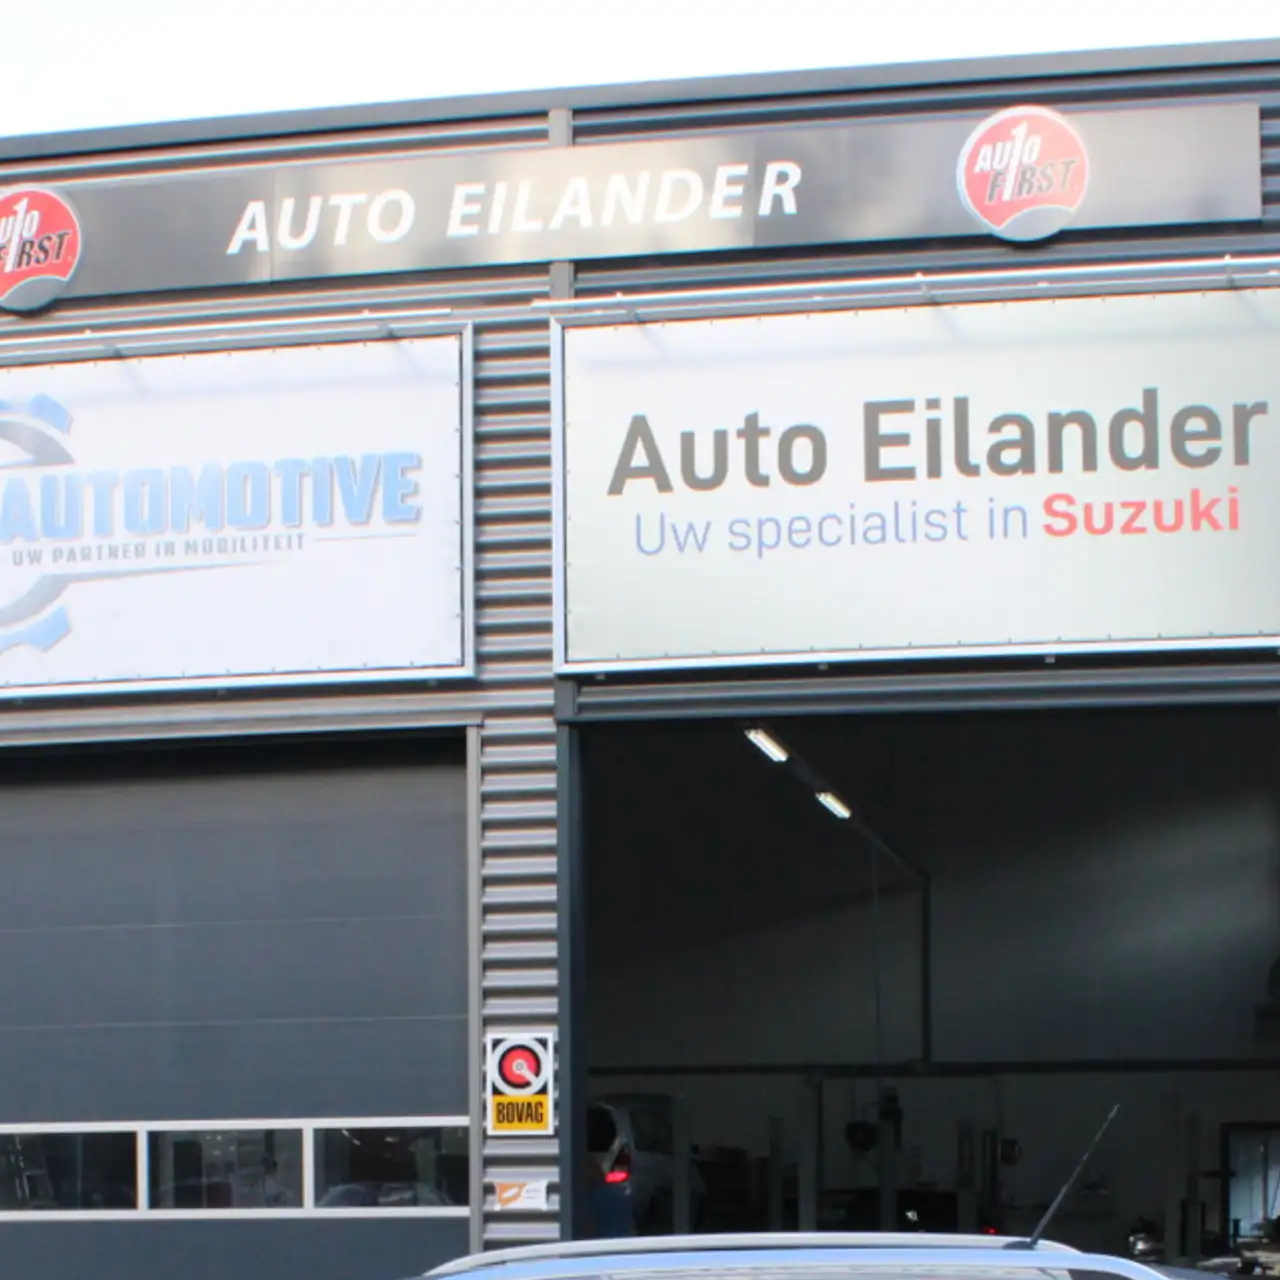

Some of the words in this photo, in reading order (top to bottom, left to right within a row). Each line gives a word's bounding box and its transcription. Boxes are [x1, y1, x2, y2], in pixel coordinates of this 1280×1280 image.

[226, 188, 417, 255] AUTO
[446, 161, 802, 239] EILANDER
[607, 409, 827, 497] Auto
[863, 386, 1269, 483] Eilander
[12, 549, 42, 566] UW
[52, 542, 146, 564] PARTNER
[155, 540, 175, 559] IN
[184, 533, 305, 556] MOBILITEIT
[634, 511, 712, 556] Uw
[728, 499, 969, 559] specialist
[988, 496, 1028, 540] in
[1042, 485, 1240, 538] Suzuki
[496, 1102, 543, 1124] BOVAG
